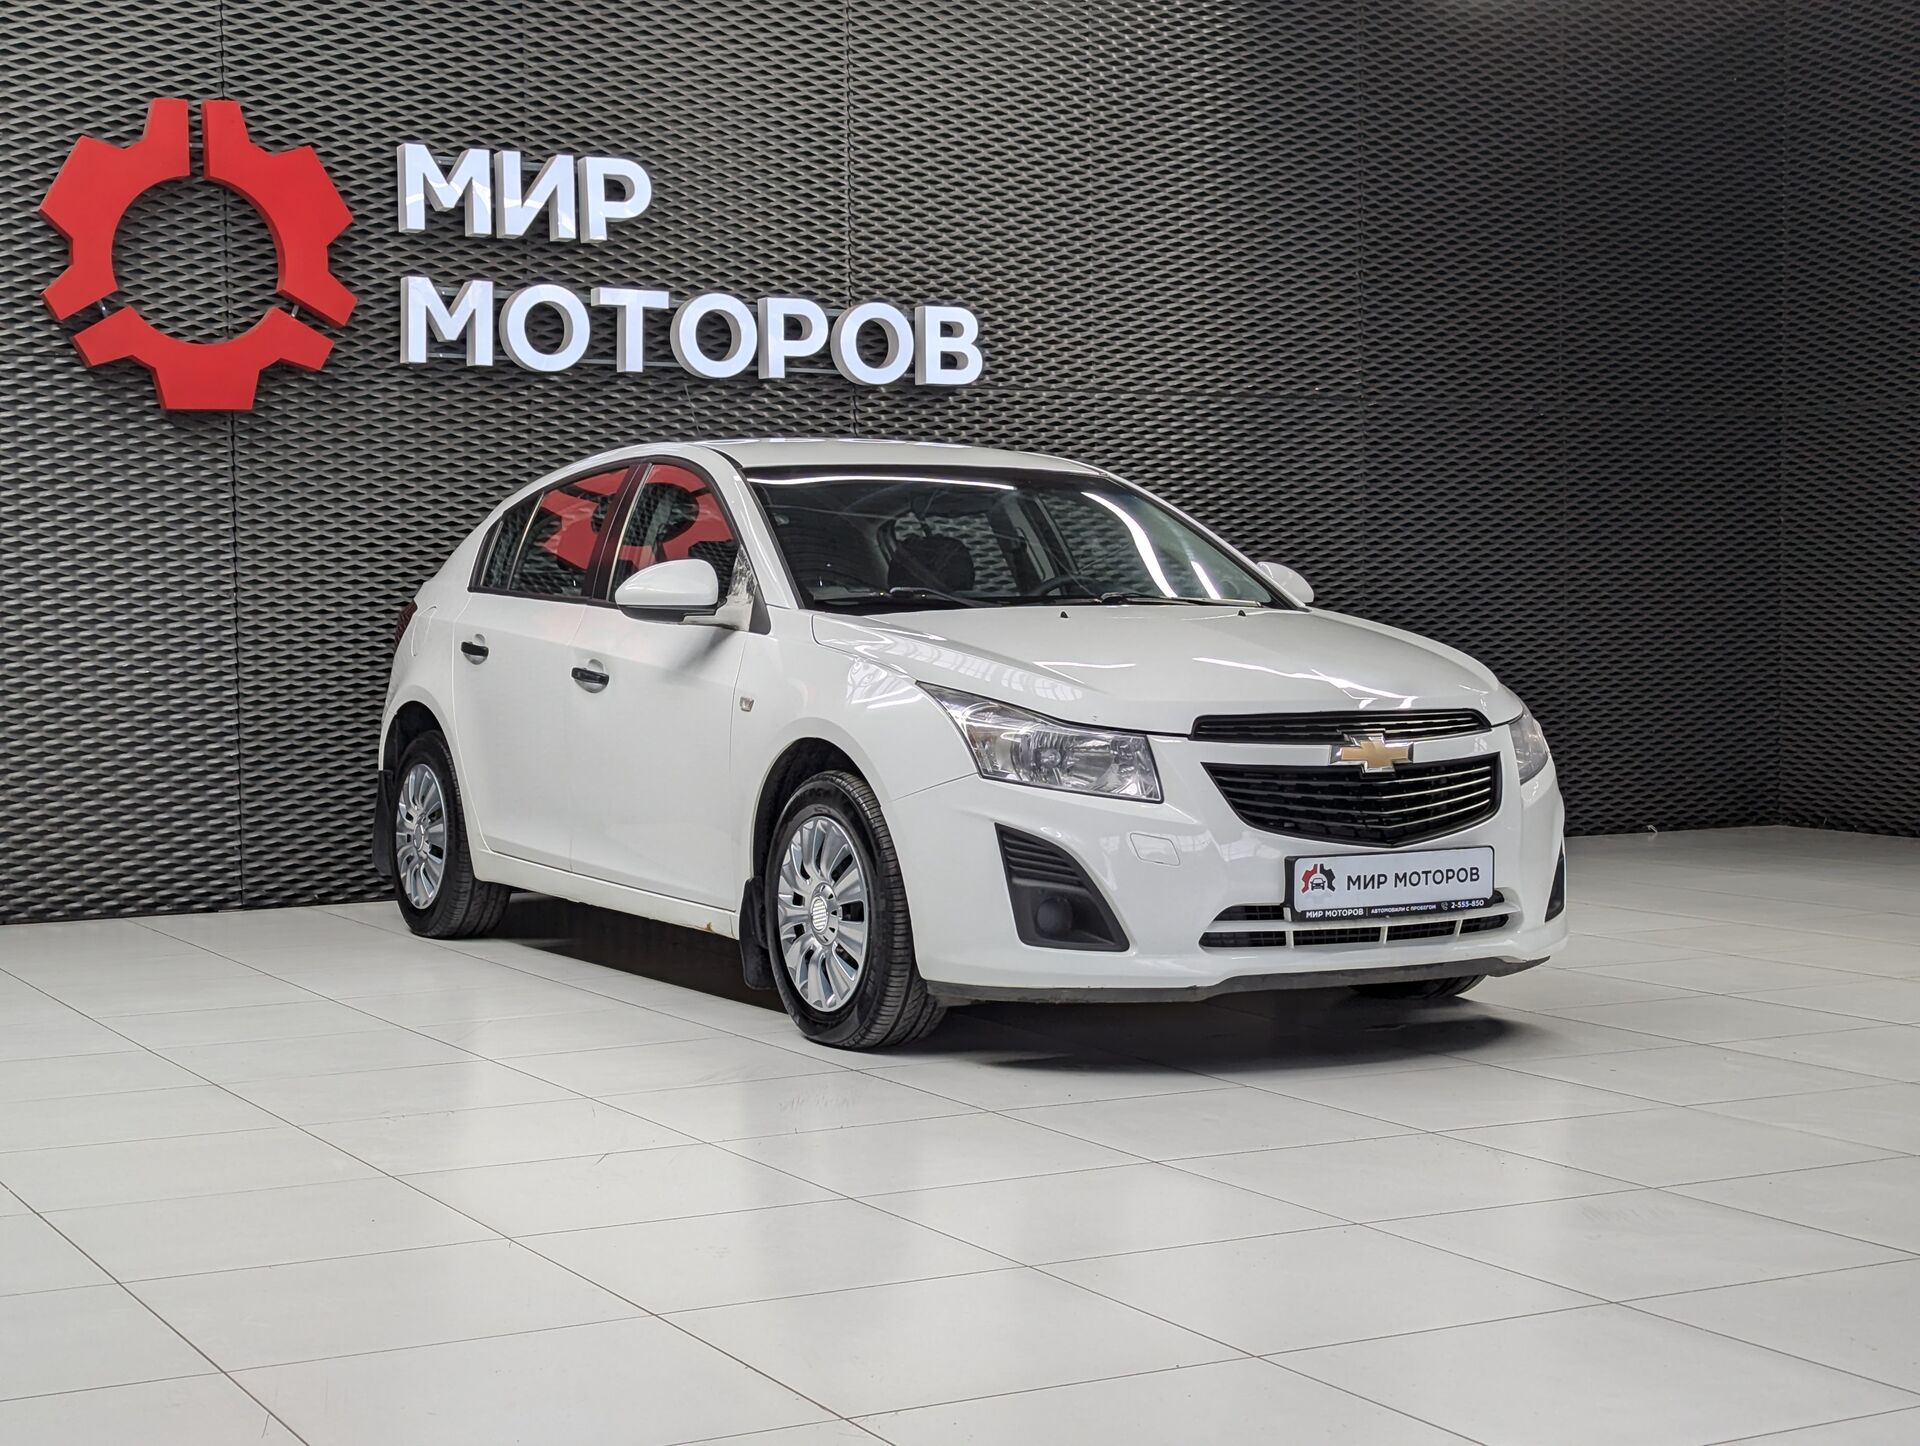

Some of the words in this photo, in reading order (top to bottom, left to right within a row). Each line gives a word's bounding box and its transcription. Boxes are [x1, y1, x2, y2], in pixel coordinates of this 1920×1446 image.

[398, 143, 652, 243] МИР
[400, 276, 984, 386] МОТОРОВ
[1347, 873, 1388, 891] МИР
[1394, 866, 1480, 888] МОТОРОВ
[1371, 906, 1405, 914] АВТОМОБИЛИ
[1451, 899, 1484, 908] 2-555-850
[1306, 910, 1323, 919] МИР
[1324, 908, 1364, 918] МОТОРОВ
